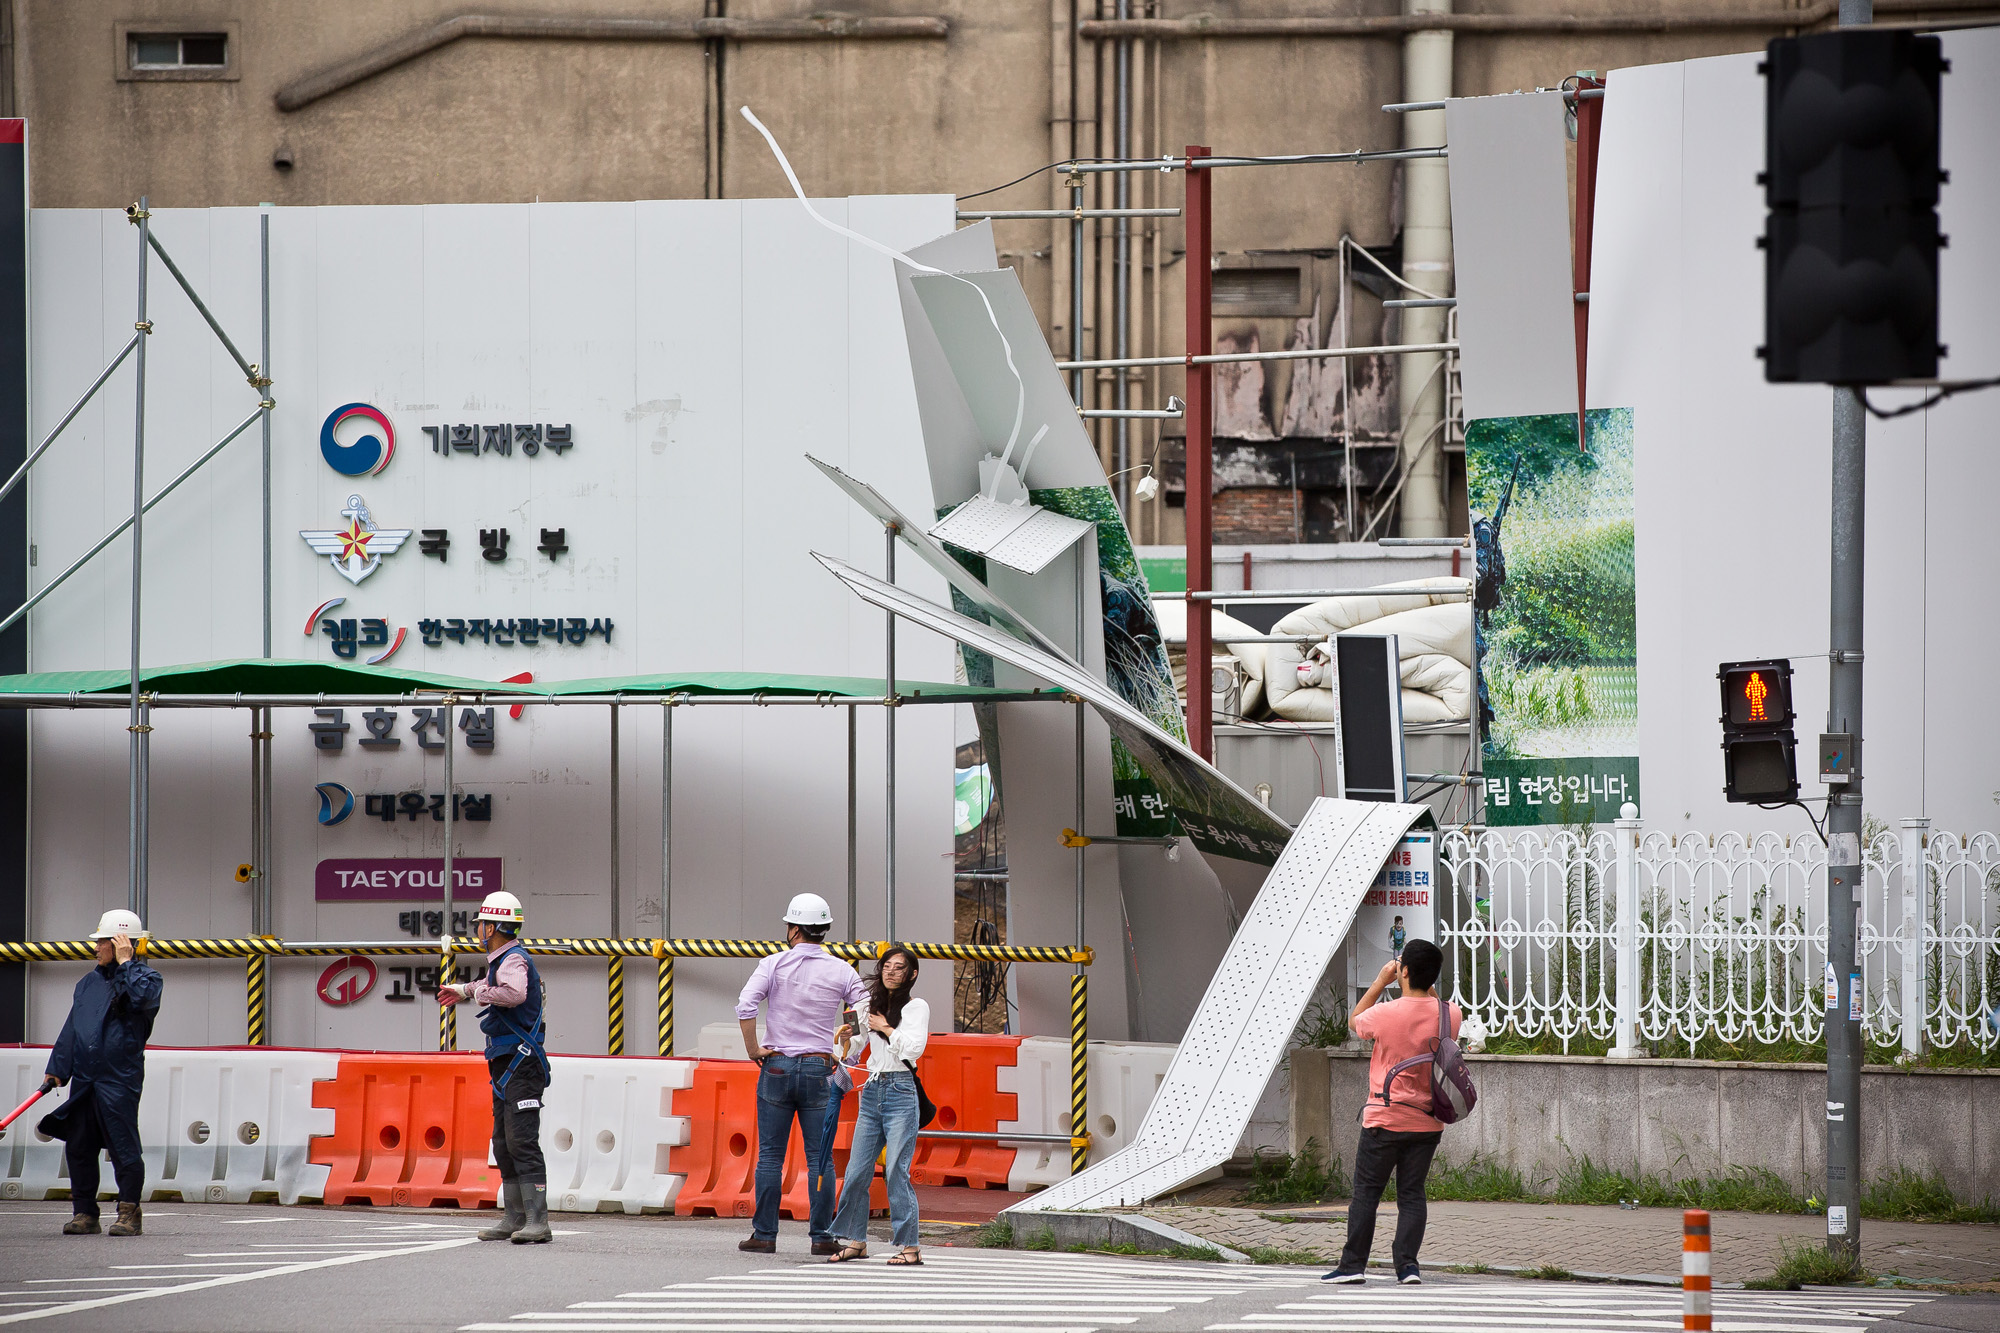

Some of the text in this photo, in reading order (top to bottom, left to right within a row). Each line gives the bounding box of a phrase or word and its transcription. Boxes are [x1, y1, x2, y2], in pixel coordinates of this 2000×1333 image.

[421, 423, 573, 456] 기획재정부
[322, 618, 388, 658] 캠코
[418, 618, 614, 645] 한국자산관리공사
[308, 707, 494, 750] 금호건설
[1519, 774, 1633, 805] 현장입니다.
[365, 793, 492, 821] 대우건설
[1114, 793, 1169, 820] 해 헌
[1182, 819, 1206, 840] 는
[1207, 824, 1261, 854] 용사를
[1384, 851, 1411, 866] 사중
[335, 869, 483, 888] TAEYOUNG
[1389, 871, 1412, 887] 불편을
[1415, 871, 1429, 887] 드려
[481, 907, 508, 915] SAFETY
[1389, 891, 1429, 907] 죄송합니다
[399, 911, 480, 936] 태영건
[519, 1100, 538, 1108] SAFETY
